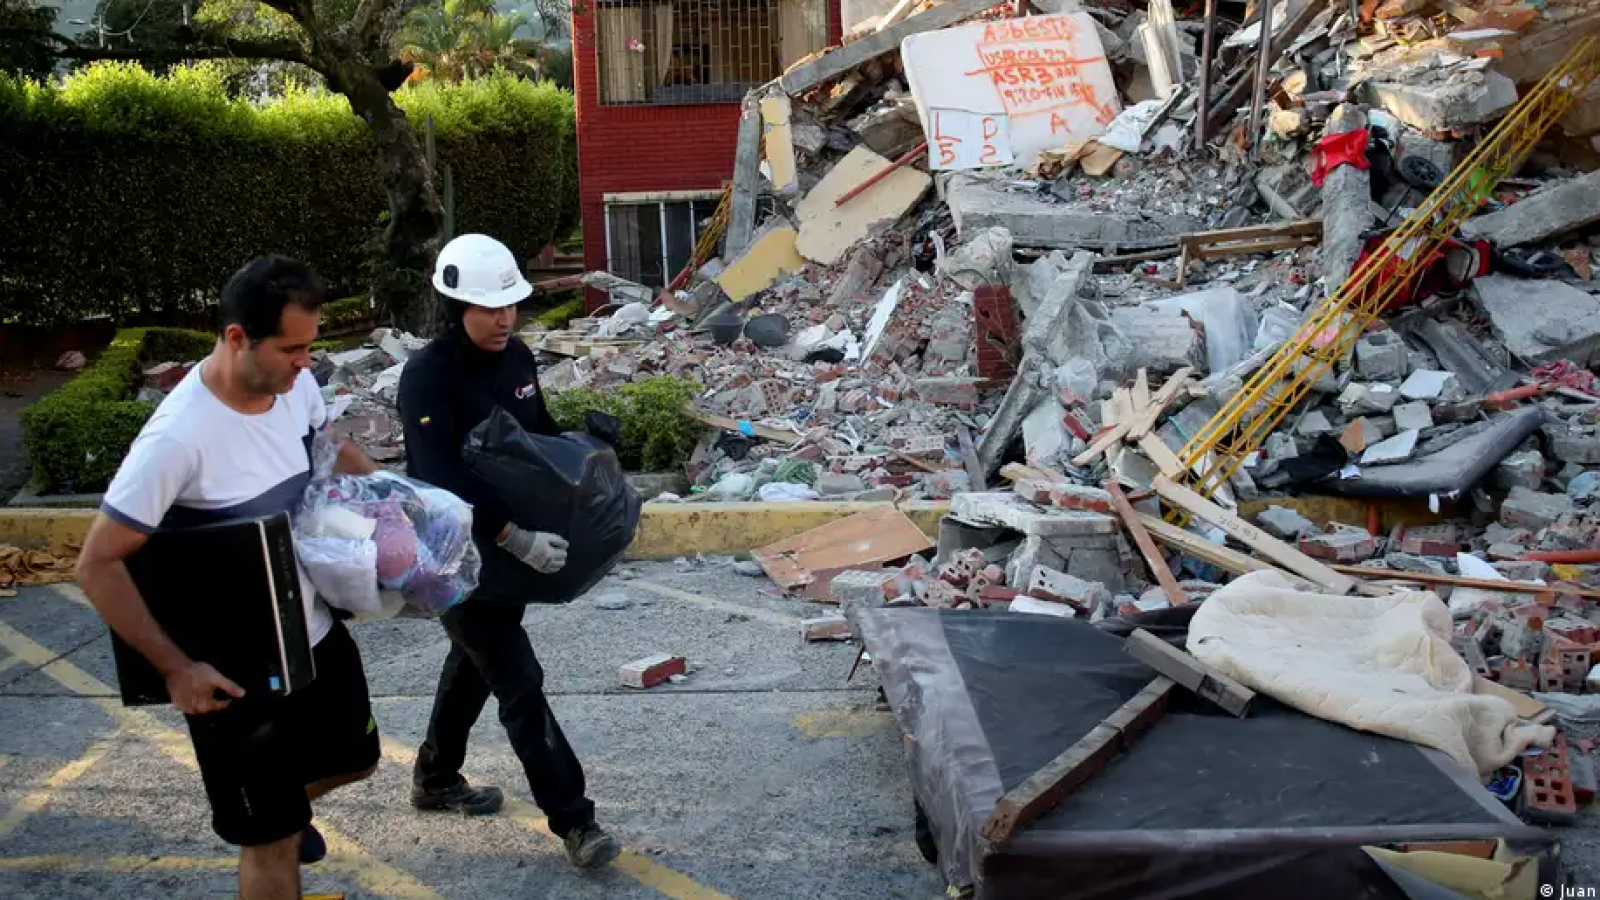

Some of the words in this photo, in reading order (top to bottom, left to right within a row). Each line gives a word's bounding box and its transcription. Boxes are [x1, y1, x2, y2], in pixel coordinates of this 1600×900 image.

[934, 112, 962, 142] L
[982, 116, 999, 140] D
[1050, 113, 1072, 134] A
[938, 143, 956, 166] 5
